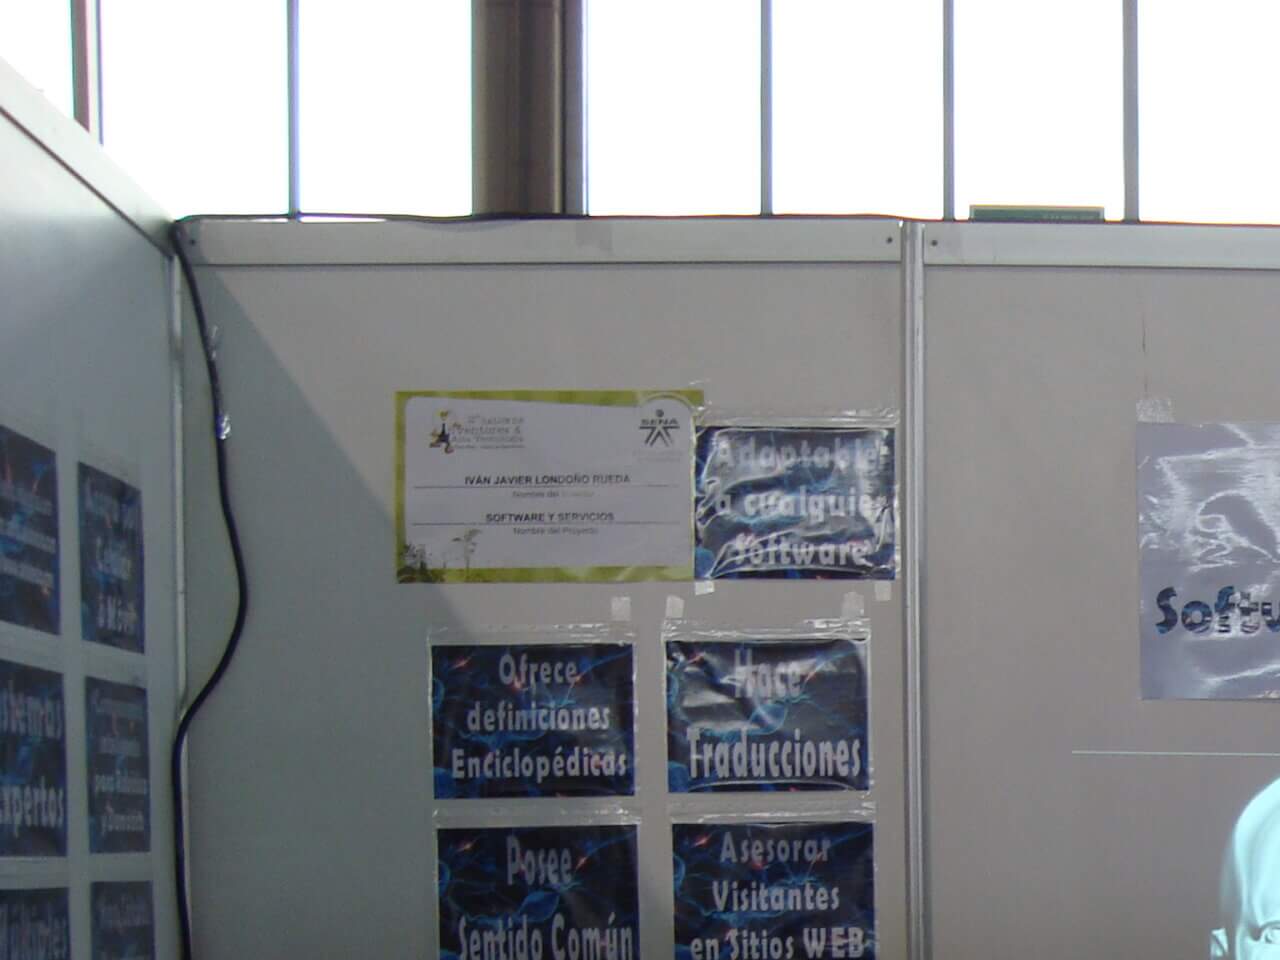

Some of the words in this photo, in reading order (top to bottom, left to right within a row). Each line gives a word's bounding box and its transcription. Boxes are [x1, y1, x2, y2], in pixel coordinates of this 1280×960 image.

[494, 474, 532, 485] JAVIER
[535, 474, 590, 485] LONDOÑO
[592, 474, 631, 485] RUEDA
[485, 512, 545, 523] SOFTWARE
[548, 512, 556, 522] Y
[557, 512, 615, 522] SERVICIOS
[734, 533, 867, 565] Software
[500, 653, 579, 690] Ofrece
[734, 648, 803, 699] Hace
[466, 700, 610, 732] definiciones
[451, 744, 627, 784] Enciclopédicas
[687, 726, 861, 779] Traducciones
[506, 836, 573, 886] Posee
[719, 831, 832, 864] Asesorar
[712, 879, 840, 912] Visitantes
[802, 926, 867, 960] WEB
